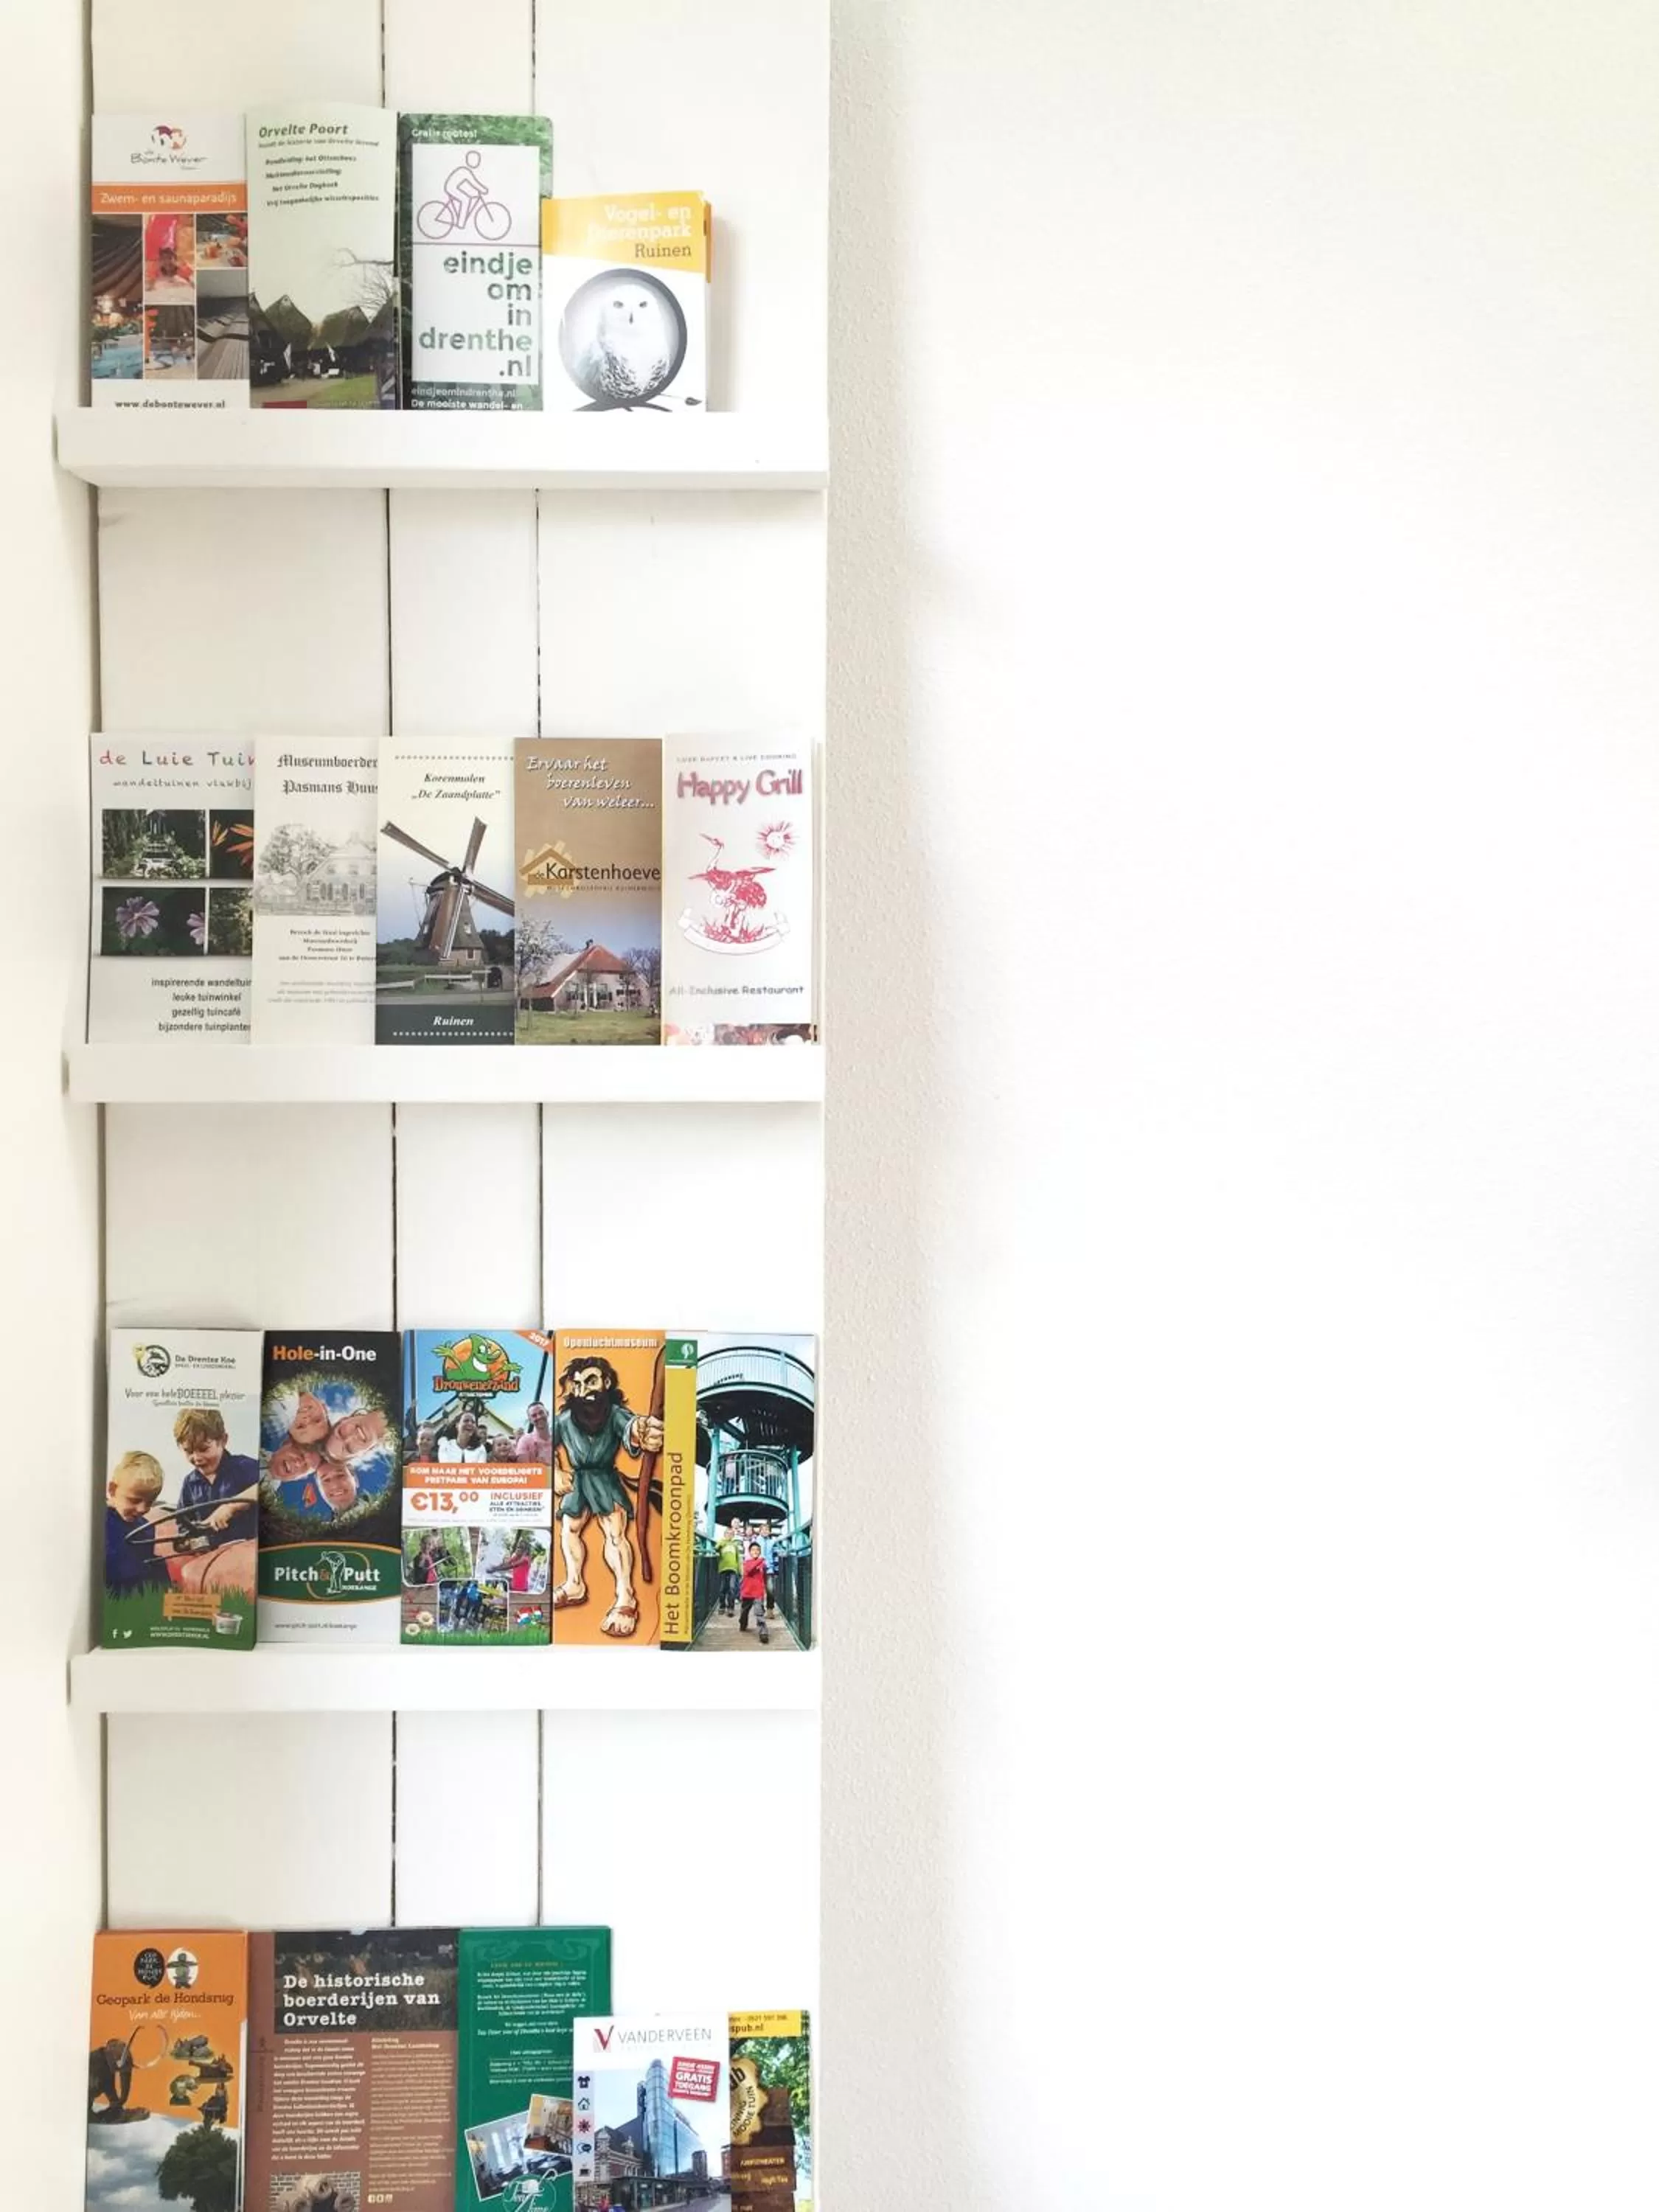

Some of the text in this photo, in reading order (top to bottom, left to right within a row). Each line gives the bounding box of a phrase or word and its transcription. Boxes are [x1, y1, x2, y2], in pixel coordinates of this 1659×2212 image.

[259, 123, 349, 138] Orvelte Poort
[100, 192, 237, 206] Zwem- en saunaparadijs
[604, 202, 692, 224] Vogel- en
[635, 243, 692, 258] Ruinen
[444, 250, 532, 280] eindje
[487, 282, 532, 301] om
[507, 303, 532, 325] in
[419, 327, 532, 352] drenthe
[499, 355, 532, 377] .nl
[411, 399, 523, 410] De mooiste wandel- en
[100, 750, 126, 765] de
[142, 751, 193, 765] Luie
[526, 755, 609, 771] Ervaar het
[424, 773, 485, 782] Korenmolen
[546, 773, 633, 790] boerenleven
[282, 779, 343, 795] Pasmans
[677, 768, 803, 805] Happy Grill
[563, 796, 594, 808] van
[546, 863, 661, 880] Karstenhoeve
[172, 992, 242, 1001] leuke tuinwinkel
[742, 985, 804, 995] Restaurant
[433, 1016, 474, 1026] Ruinen
[273, 1346, 377, 1362] Hole-in-One
[490, 1492, 543, 1500] INCLUSIEF
[664, 1452, 685, 1634] Het Boomkroonpad
[274, 1566, 319, 1582] Pitch
[344, 1567, 380, 1582] Putt
[283, 1973, 425, 1989] De historische
[97, 1992, 234, 2006] Geopark de Hondsrug
[283, 1993, 440, 2009] boerderijen van
[284, 2012, 357, 2026] Orvelte
[617, 2028, 712, 2045] VANDERVEEN
[675, 2072, 713, 2084] GRATIS
